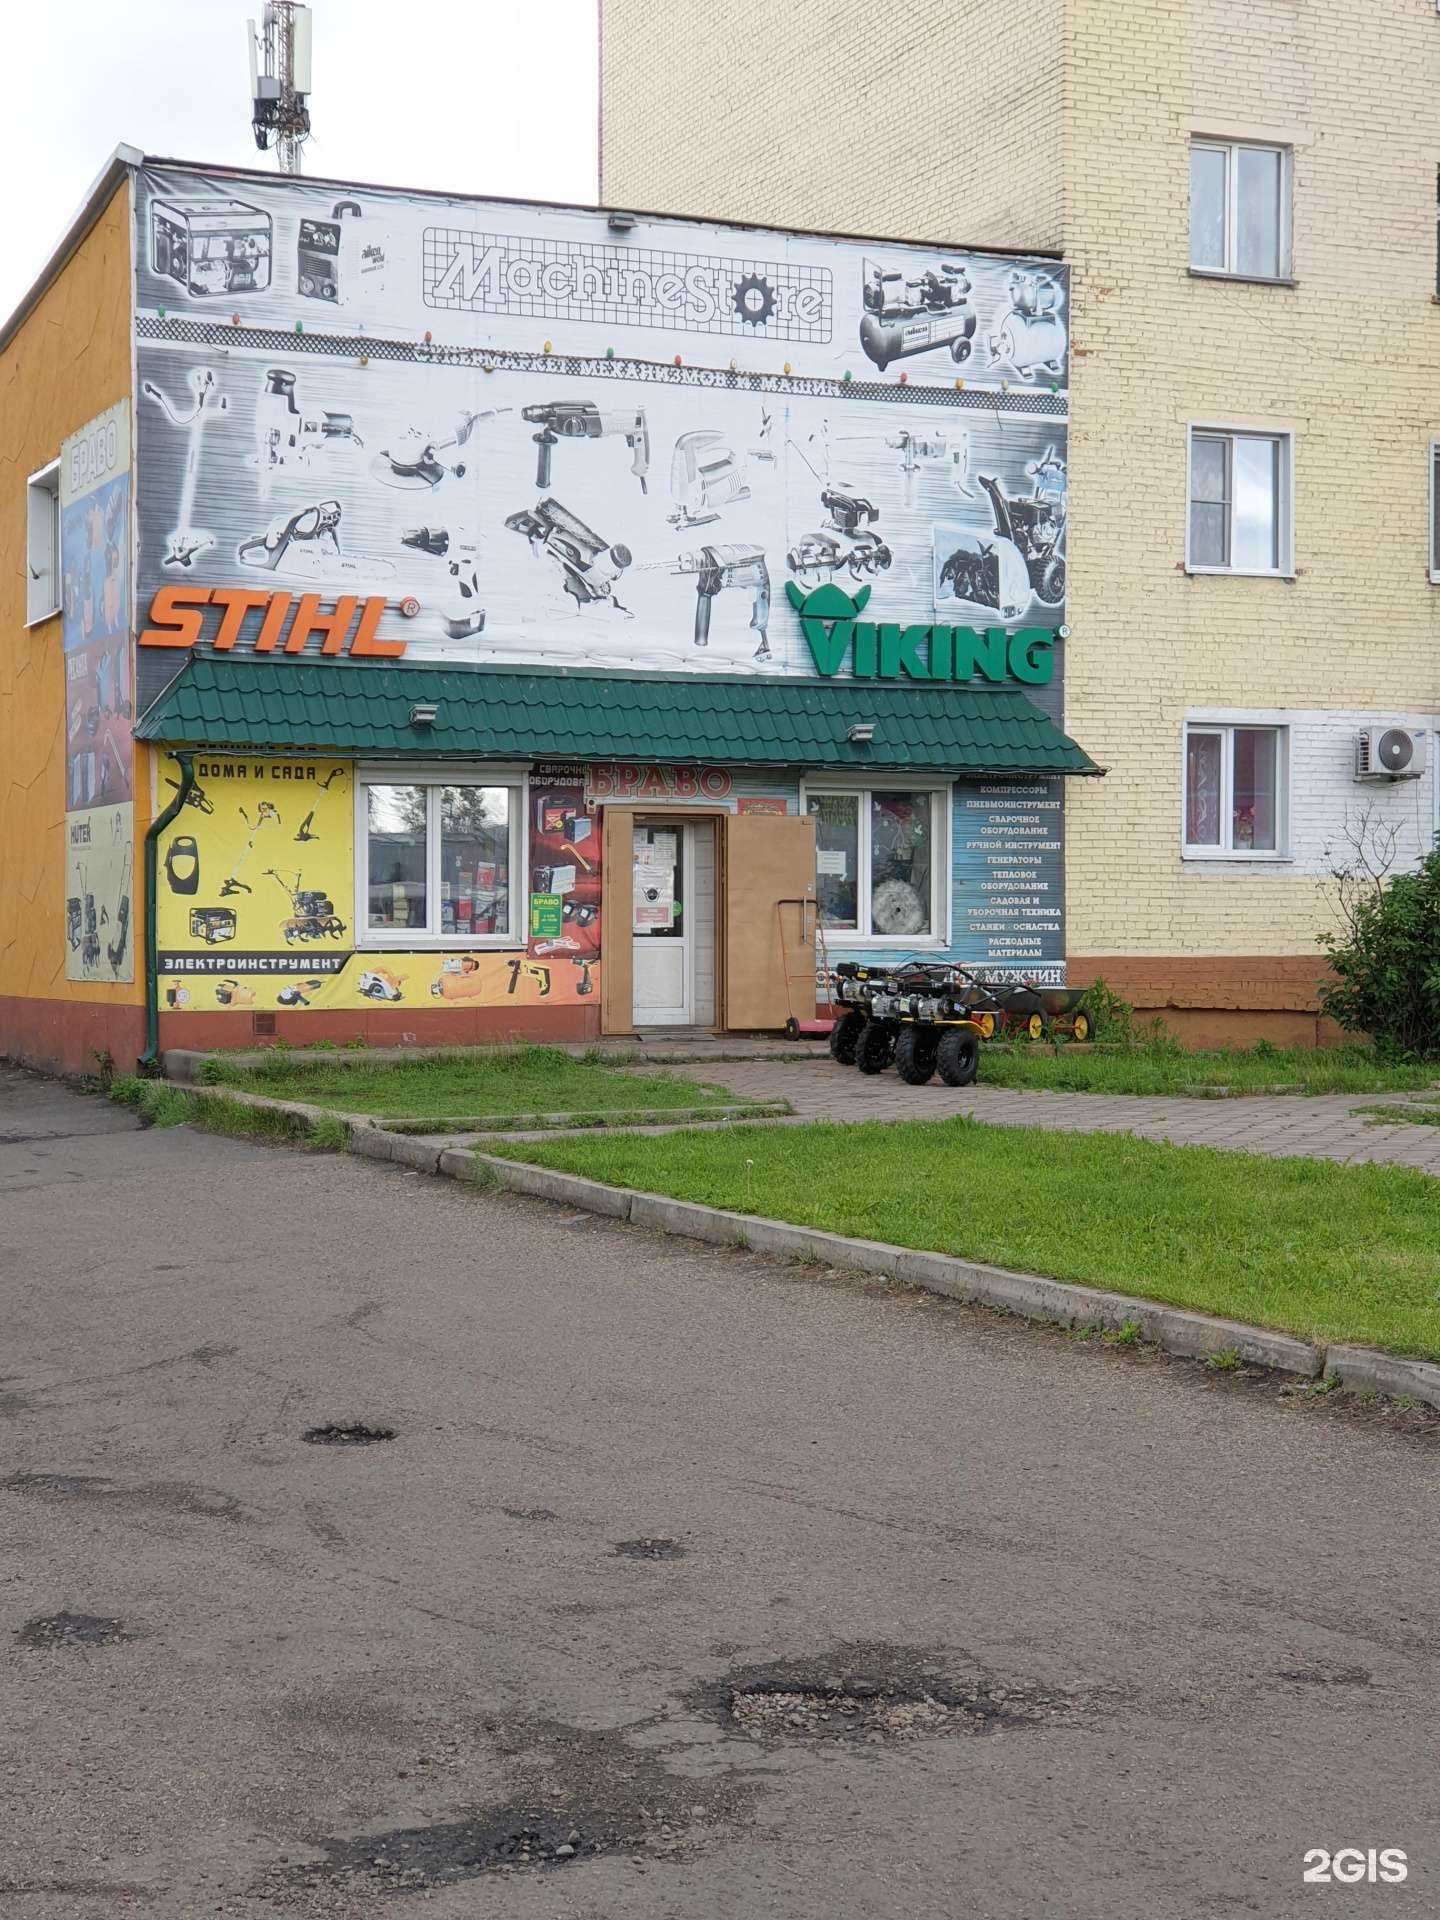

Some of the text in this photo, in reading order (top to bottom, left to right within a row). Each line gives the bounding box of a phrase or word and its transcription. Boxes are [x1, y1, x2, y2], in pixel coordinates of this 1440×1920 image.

[579, 359, 727, 388] МЕХАНИЗМОВ
[761, 377, 841, 396] МАШИН
[139, 586, 407, 658] STIHL
[800, 619, 1054, 685] VIKING
[198, 763, 316, 780] ДОМА И САДА
[586, 764, 733, 800] БРАВО
[980, 786, 1048, 794] КОМПРЕССОРЫ
[966, 800, 1061, 809] ПНЕВМОИНСТРУМЕНТ
[988, 815, 1040, 823] СВАРОЧНОЕ
[980, 827, 1049, 835] ОБОРУДОВАНИЕ
[966, 840, 1061, 849] РУЧНОЙ ИНСТРУМЕНТ
[987, 856, 1042, 864] ГЕНЕРАТОРЫ
[992, 870, 1037, 879] ТЕПЛОВОЕ
[980, 882, 1049, 891] ОБОРУДОВАНИЕ
[990, 897, 1040, 905] САДОВАЯ И
[967, 908, 1062, 916] УБОРОЧНАЯ ТЕХНИКА
[969, 923, 1060, 931] СТАНКИ ОСНАСТКА
[988, 937, 1042, 946] РАСХОДНЫЕ
[987, 949, 1042, 957] МАТЕРИАЛЫ
[164, 957, 341, 970] ЭЛЕКТРОИНСТРУМЕНТ
[985, 969, 1062, 984] МУЖЧИН
